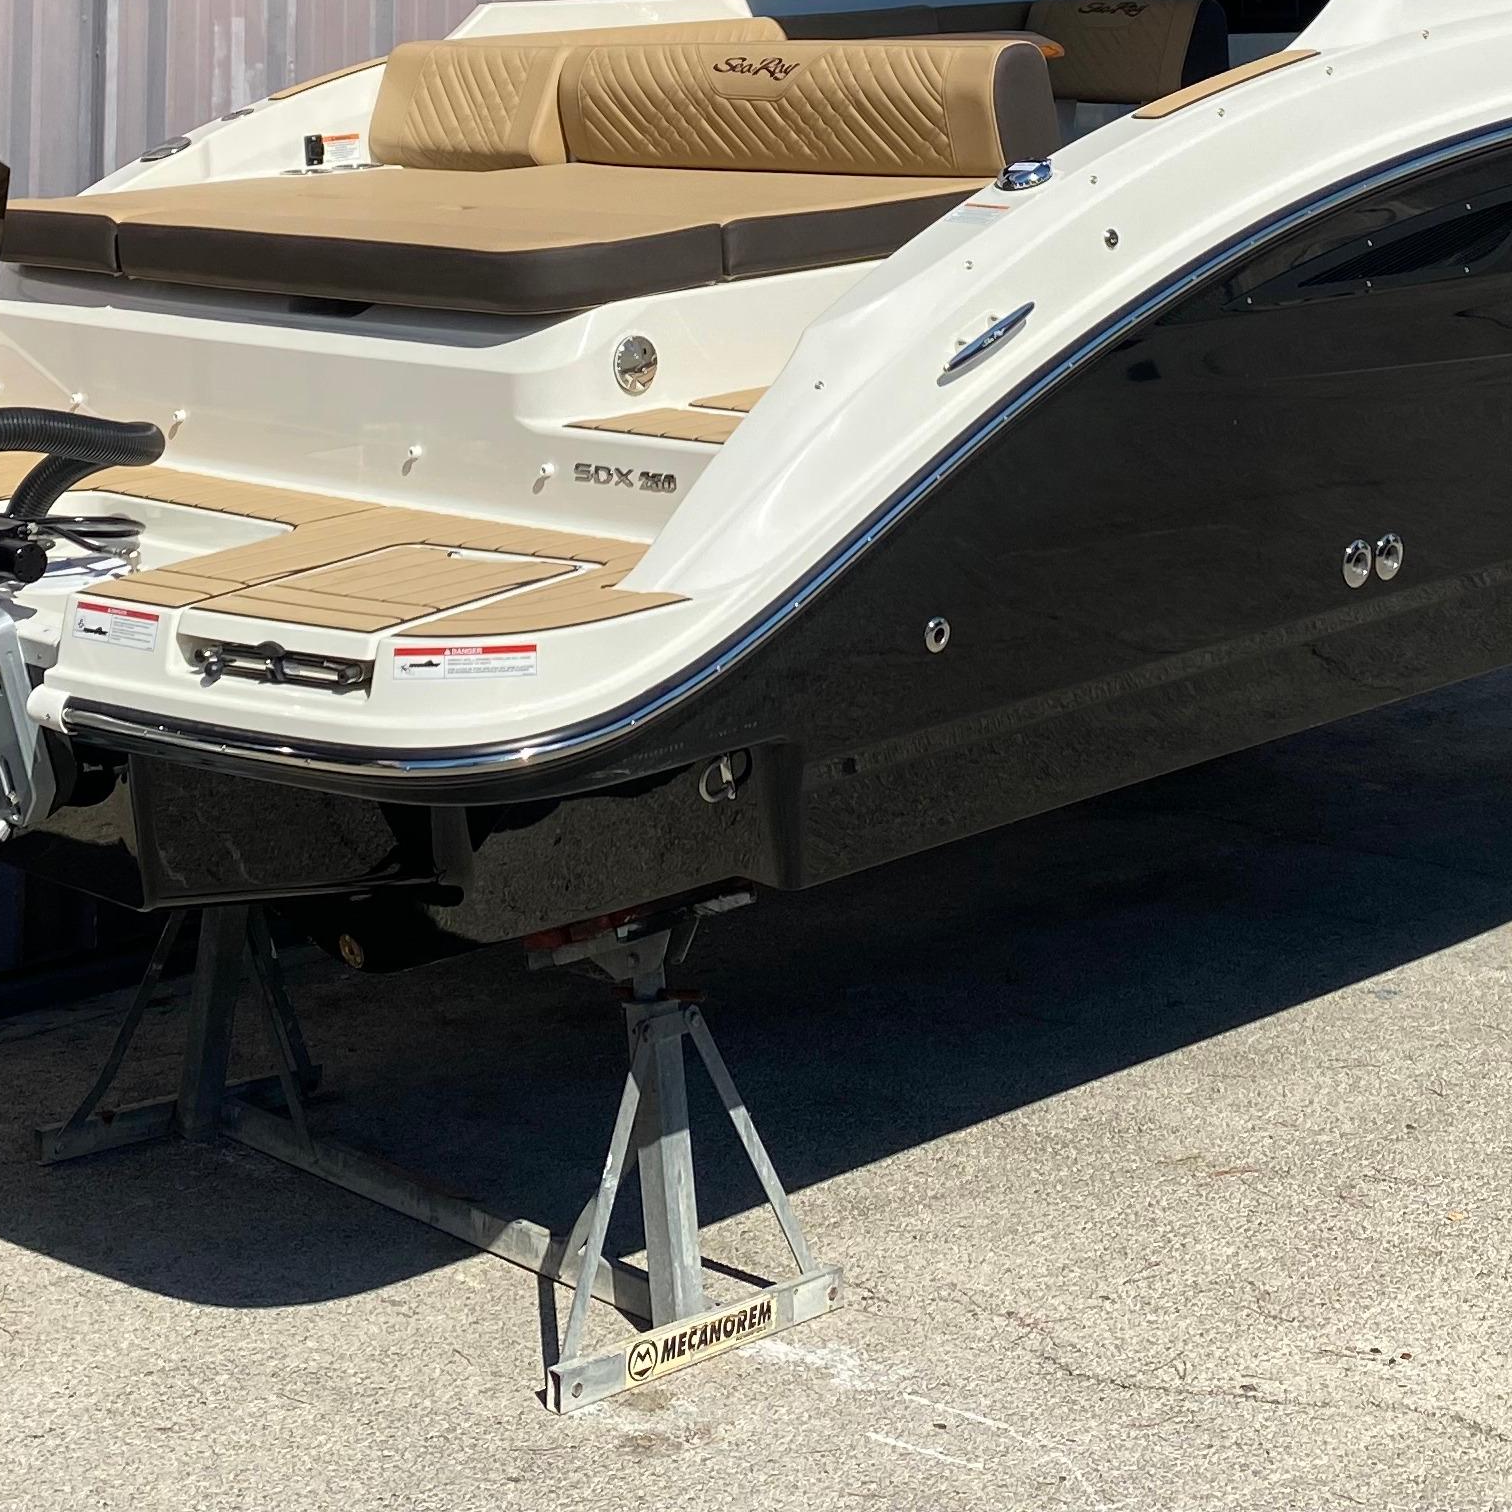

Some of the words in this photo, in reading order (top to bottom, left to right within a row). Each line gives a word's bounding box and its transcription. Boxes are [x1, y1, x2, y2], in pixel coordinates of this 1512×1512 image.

[713, 57, 754, 74] Sea
[751, 57, 801, 81] Ray
[573, 462, 634, 488] SDX
[659, 1300, 772, 1364] MECANOREM
